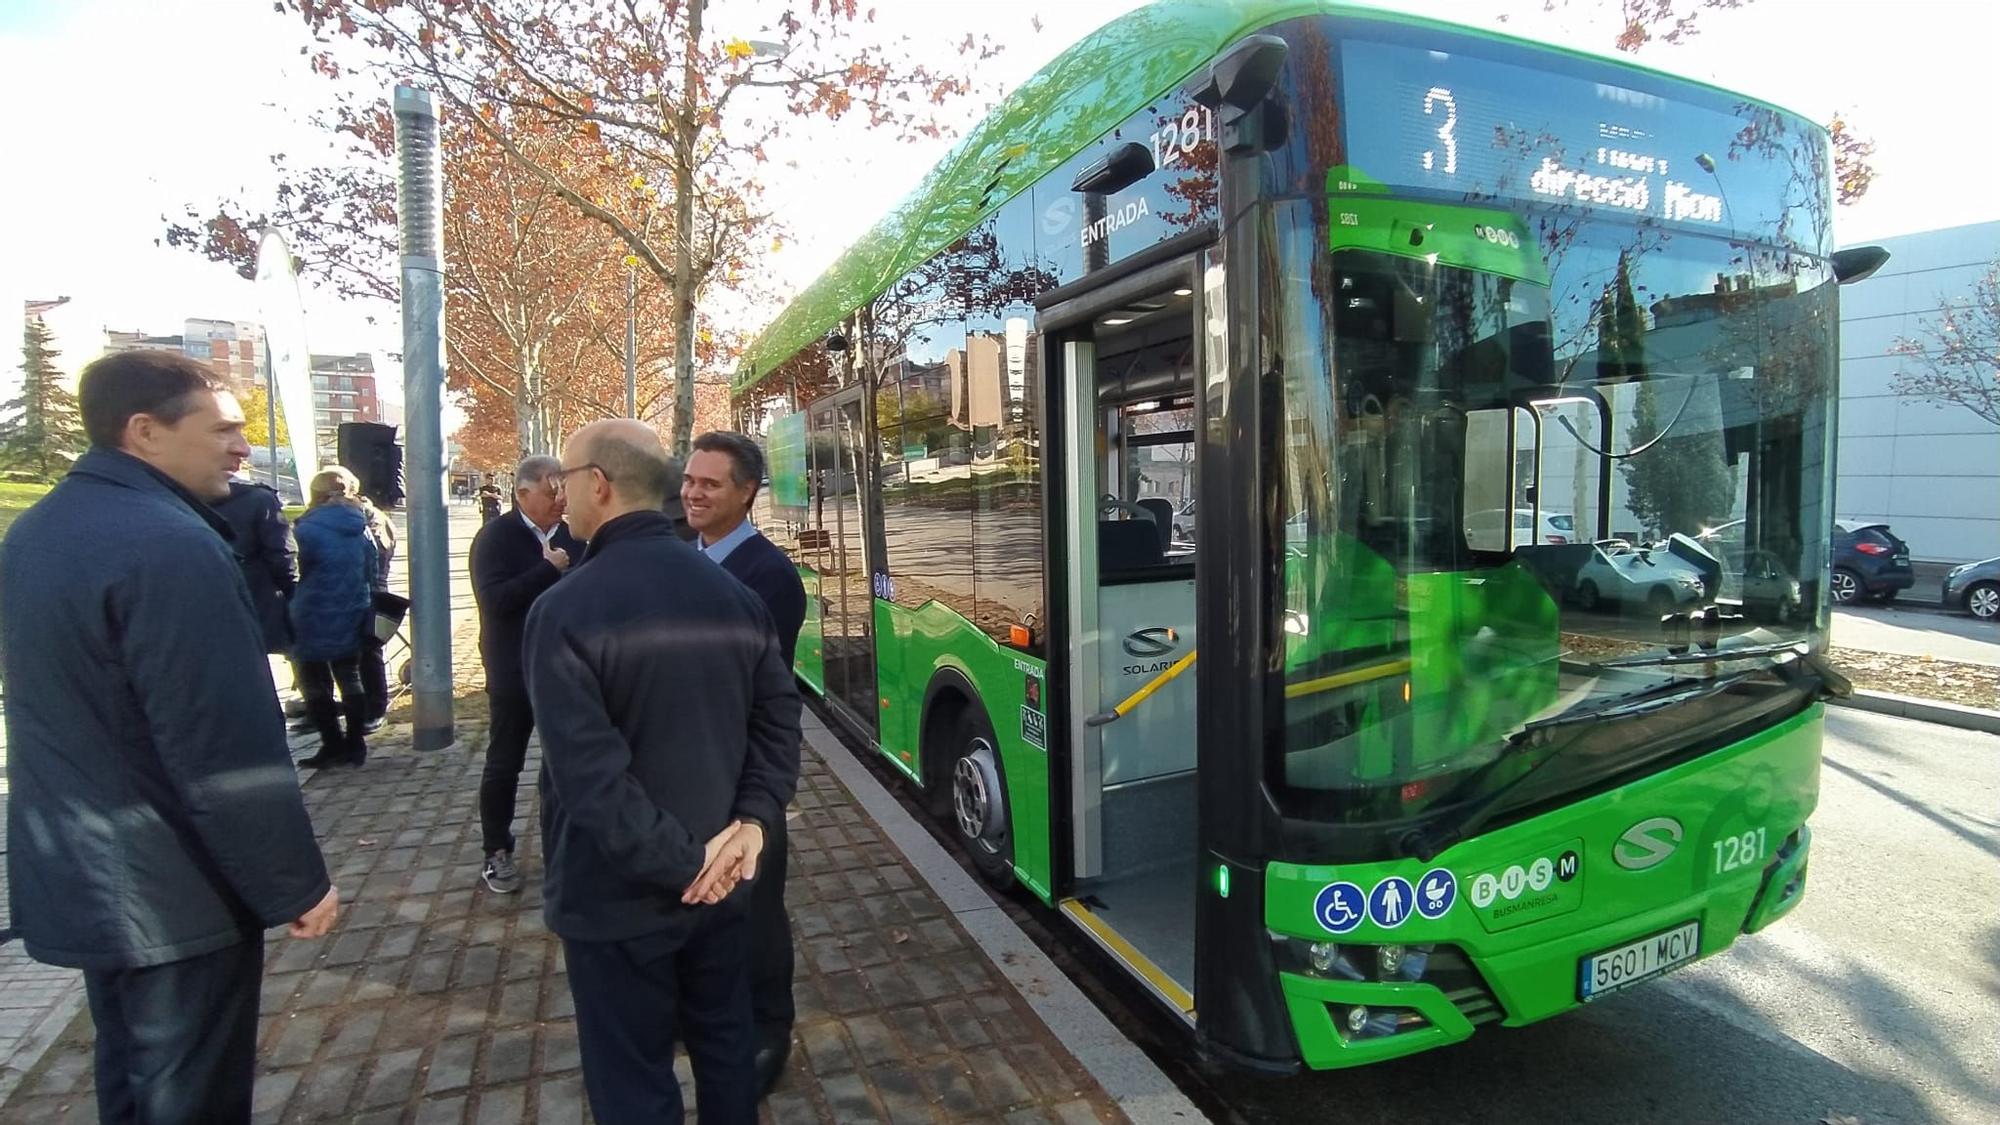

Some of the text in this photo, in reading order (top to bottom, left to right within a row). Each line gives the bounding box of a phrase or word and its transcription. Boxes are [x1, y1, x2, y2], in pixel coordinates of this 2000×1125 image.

[1150, 104, 1212, 170] 1281
[1423, 86, 1457, 173] 3
[1080, 197, 1149, 247] ENTRADA
[1014, 658, 1045, 680] ENTRADA
[1713, 827, 1766, 874] 1281
[1493, 893, 1558, 919] BUSMANRESA
[1597, 945, 1648, 987] 5601
[1657, 927, 1693, 965] MCV
